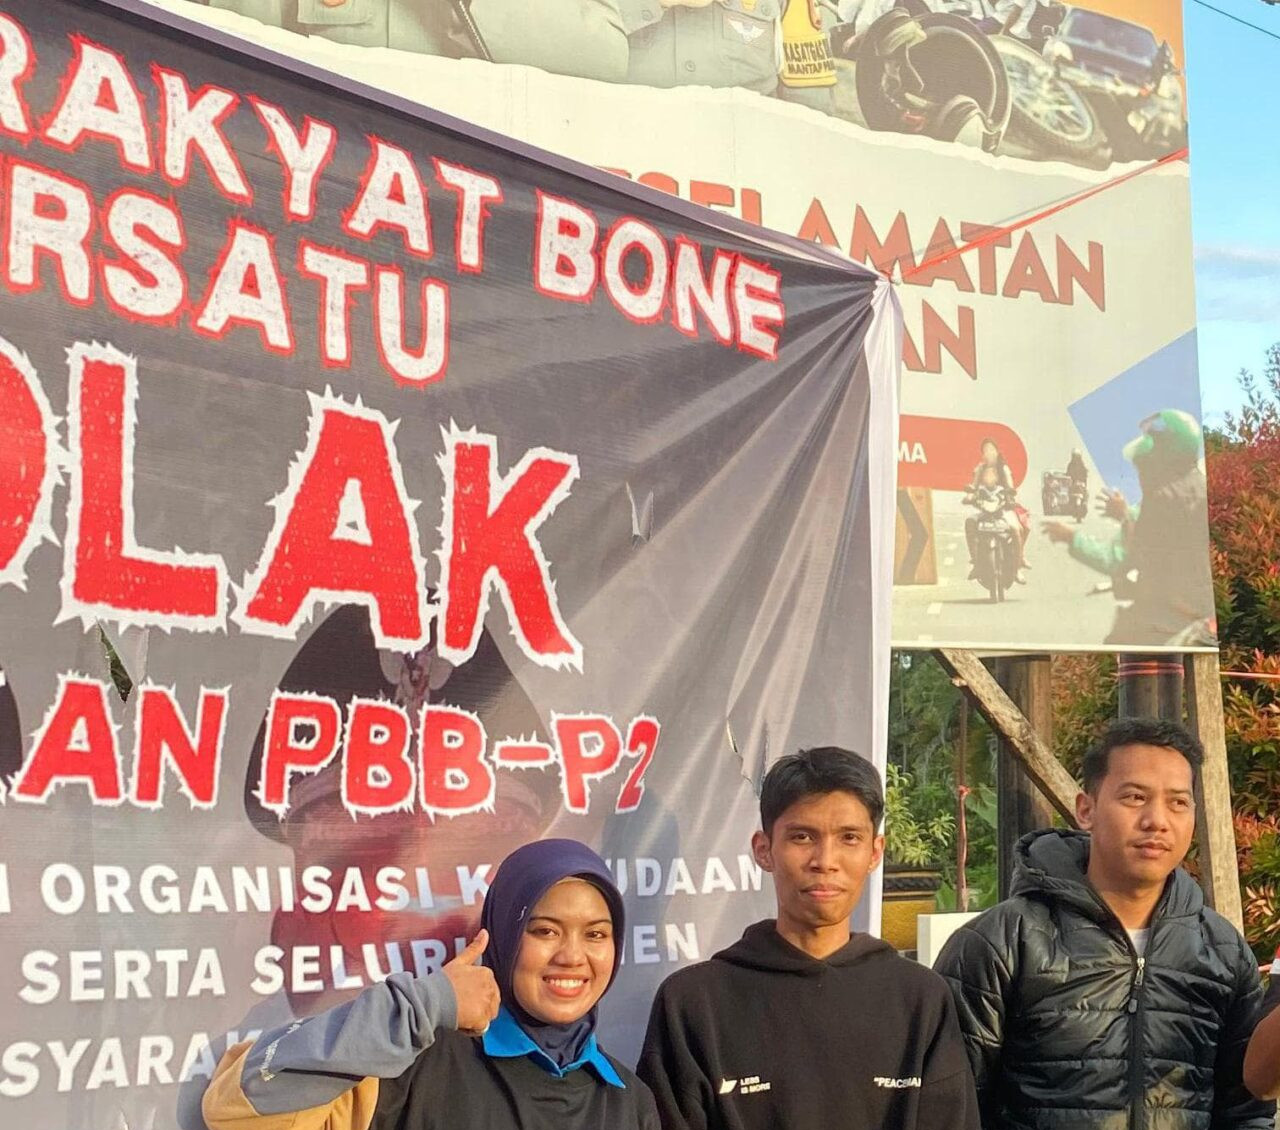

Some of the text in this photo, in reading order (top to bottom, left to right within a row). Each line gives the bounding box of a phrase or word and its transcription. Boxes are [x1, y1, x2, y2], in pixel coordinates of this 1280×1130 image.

[533, 188, 788, 362] BONE
[0, 669, 661, 824] AN PBB-P2
[40, 862, 435, 915] ORGANISASI
[18, 948, 226, 1004] SERTA
